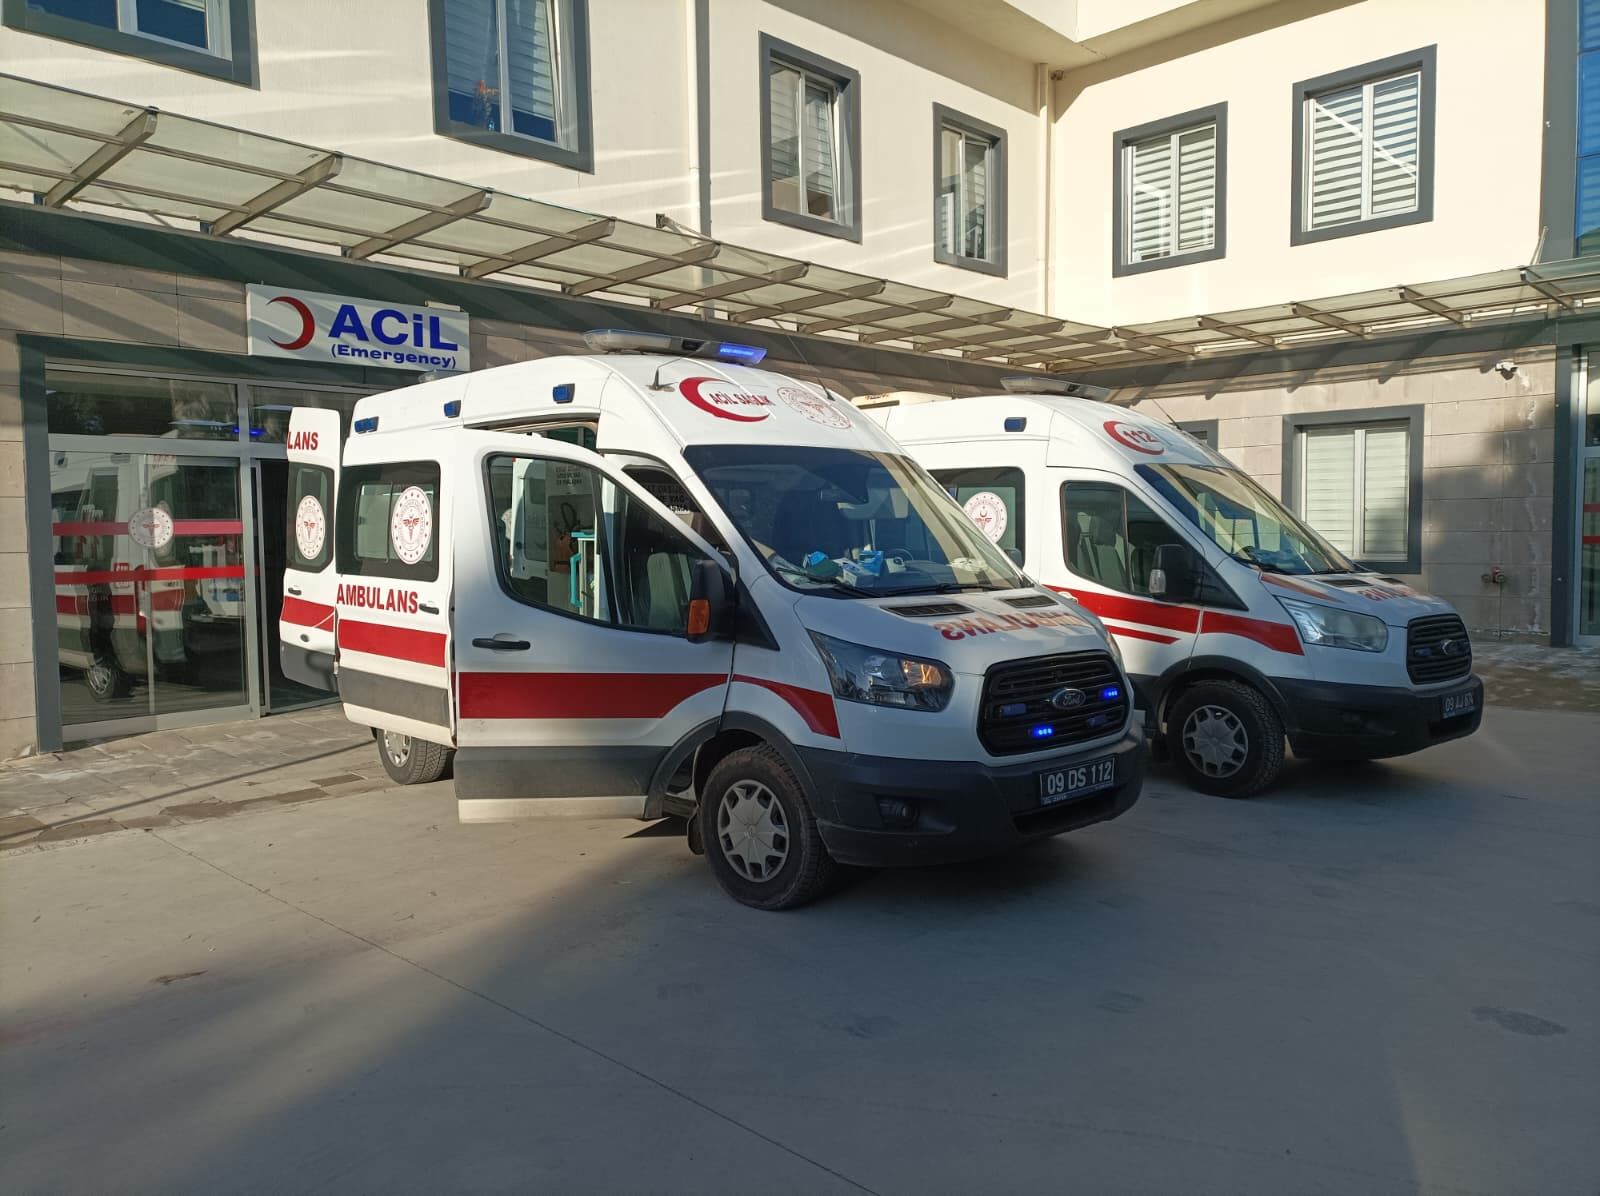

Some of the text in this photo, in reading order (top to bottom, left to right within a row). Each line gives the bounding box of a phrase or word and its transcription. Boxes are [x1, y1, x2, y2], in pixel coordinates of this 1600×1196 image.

[331, 344, 456, 369] (Emergency)
[1123, 430, 1160, 443] 112
[336, 583, 419, 614] AMBULANS
[1047, 761, 1111, 794] 09 DS 112
